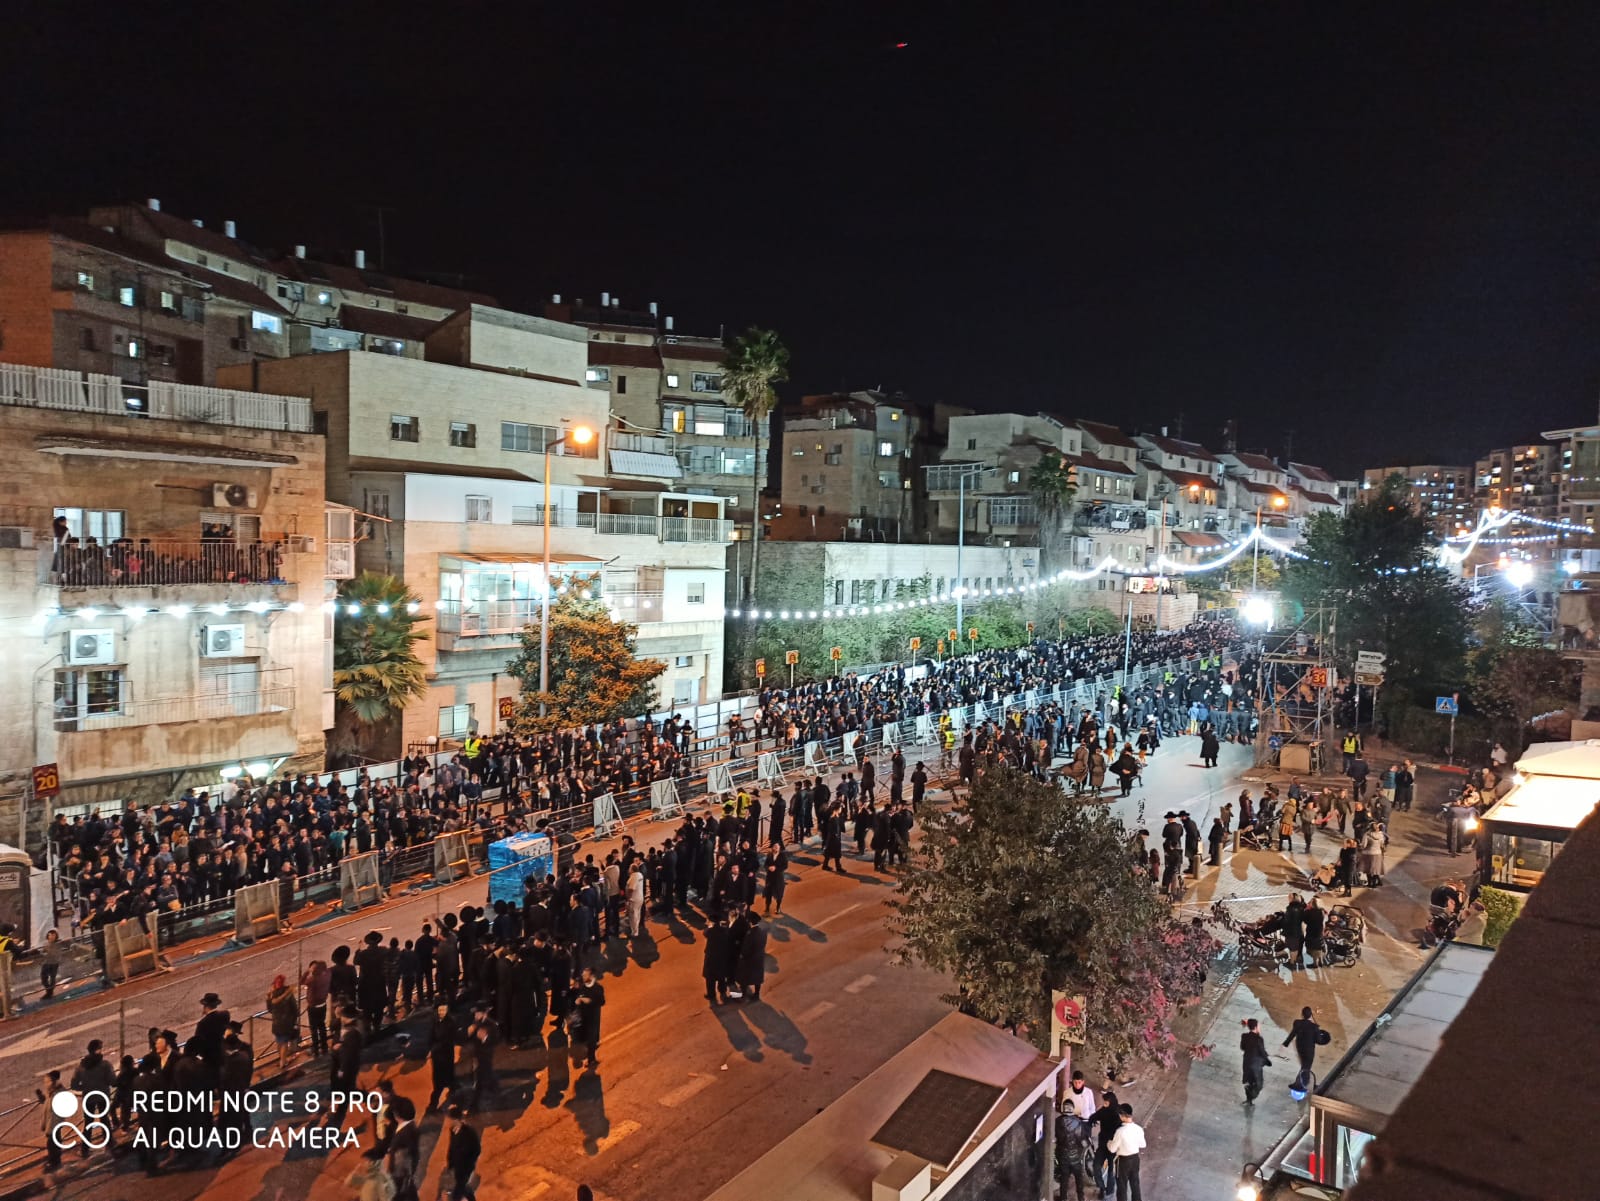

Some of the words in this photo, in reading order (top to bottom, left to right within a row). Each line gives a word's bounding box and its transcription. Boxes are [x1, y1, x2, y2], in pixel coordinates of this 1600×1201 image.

[1313, 672, 1327, 685] 31
[501, 704, 511, 715] 19
[36, 774, 57, 791] 20
